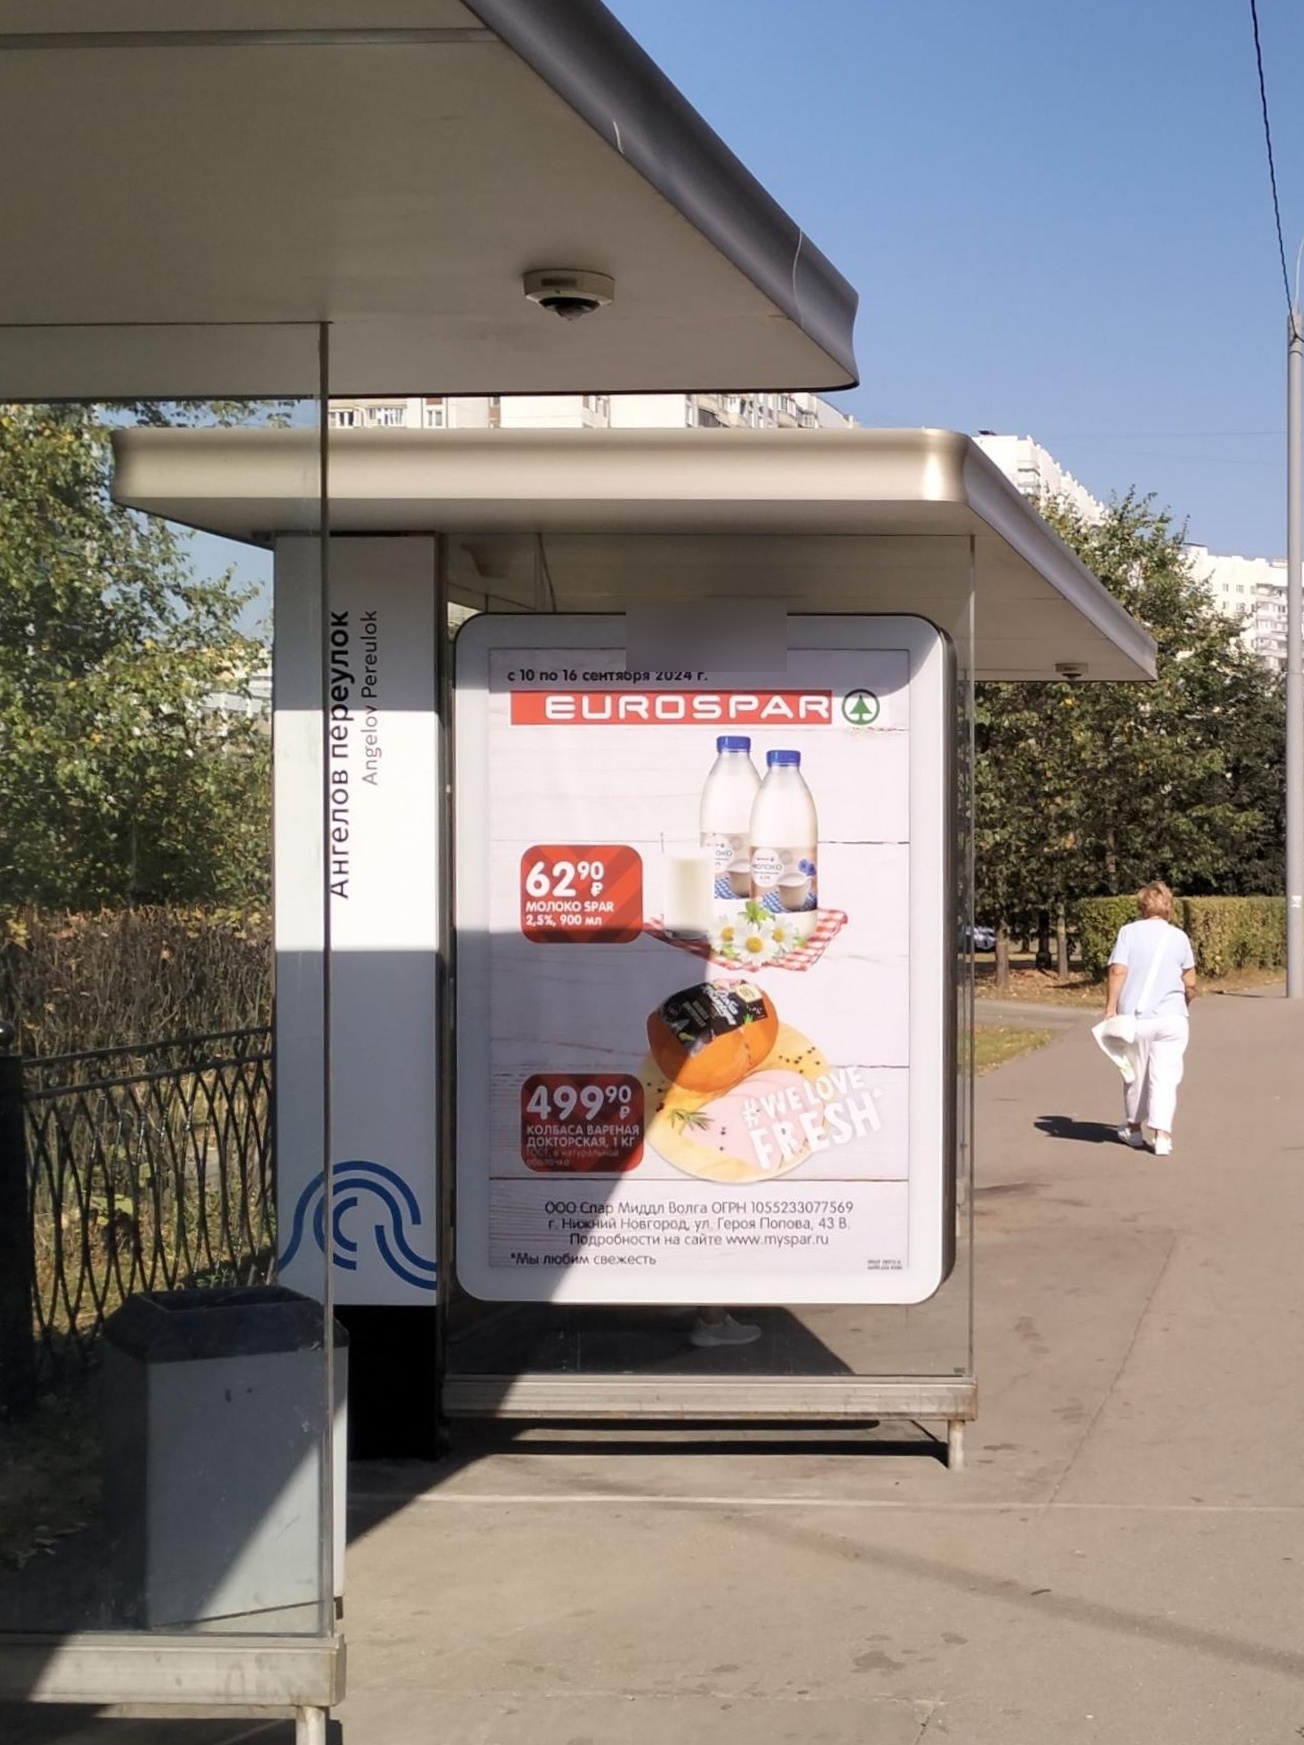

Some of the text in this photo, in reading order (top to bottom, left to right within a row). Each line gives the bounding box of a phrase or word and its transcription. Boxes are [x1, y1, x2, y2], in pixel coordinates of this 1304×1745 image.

[507, 670, 515, 682] с
[519, 669, 535, 682] 10
[539, 670, 558, 682] по
[563, 669, 578, 682] 16
[582, 669, 650, 684] сентября
[655, 671, 692, 682] 2024
[360, 610, 382, 786] Angelov Pereulok
[545, 694, 830, 720] EUROSPAR
[330, 611, 355, 899] Ангелов переулок
[525, 901, 615, 912] МОЛОКО SPAR
[525, 914, 602, 927] 2,5%, 900 мл
[741, 1067, 865, 1128] #WE LOVE
[526, 1124, 640, 1136] КОЛБАСА ВАРЕНАЯ
[526, 1136, 635, 1148] ДОКТОРСКАЯ, 1 КГ
[544, 1201, 854, 1217] ООО Спар Миддл Волга ОГРН 1055233077569
[562, 1217, 617, 1230] Нижний
[620, 1218, 690, 1232] Новгород,
[694, 1219, 713, 1232] ул.
[717, 1217, 756, 1232] Героя
[759, 1217, 814, 1231] Попова,
[818, 1217, 835, 1230] 43
[569, 1233, 829, 1248] Подробности на сайте www.myspar.ru
[543, 1253, 590, 1265] любим
[593, 1254, 657, 1265] свежесть
